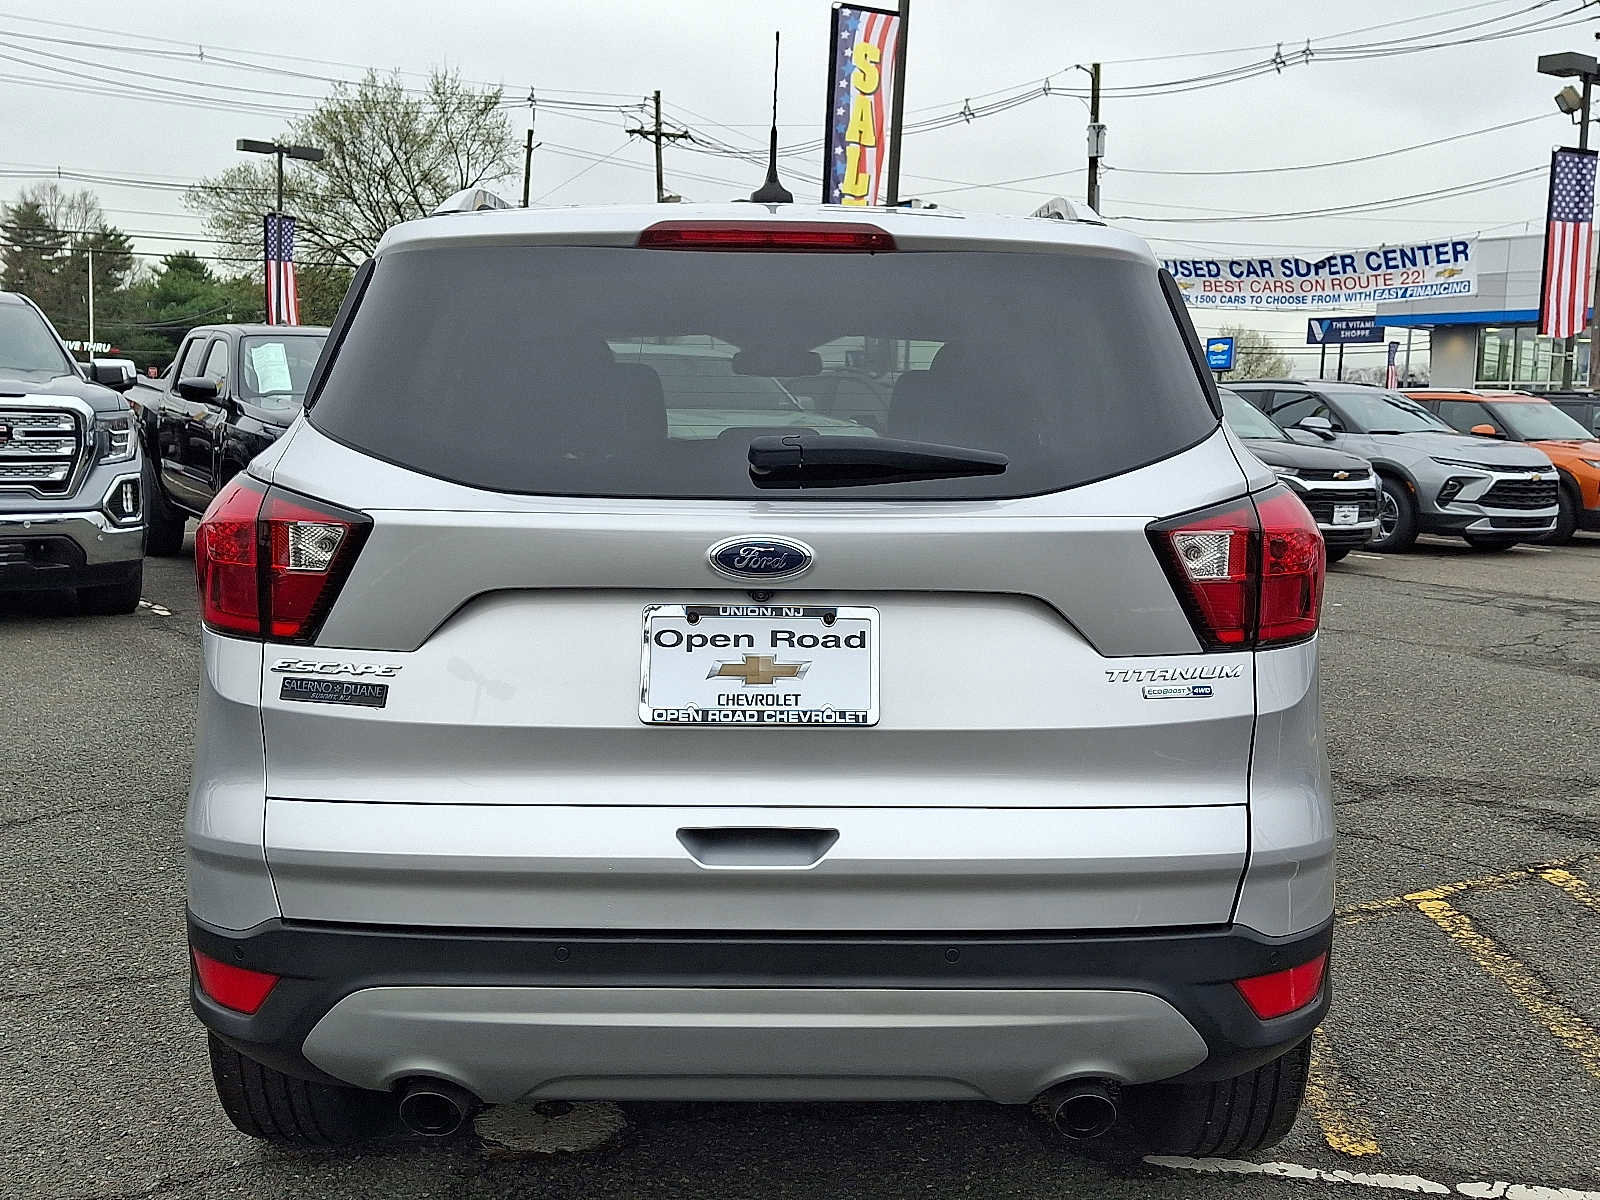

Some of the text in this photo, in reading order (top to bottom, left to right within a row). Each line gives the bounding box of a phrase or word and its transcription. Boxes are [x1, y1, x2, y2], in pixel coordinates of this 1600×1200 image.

[1163, 241, 1469, 278] USED CAR SUPER CENTER
[1203, 270, 1425, 293] BEST CARS ON ROUTE 22!
[1194, 295, 1217, 304] 1500
[1220, 295, 1246, 304] CARS
[1250, 295, 1263, 304] TO
[1265, 295, 1308, 305] CHOOSE
[1311, 293, 1341, 304] FROM
[1344, 291, 1372, 302] WITH
[1374, 288, 1405, 300] EASY
[1406, 282, 1469, 297] FINANCING
[1332, 320, 1377, 329] THE VITAMI
[734, 546, 788, 569] Ford
[782, 605, 805, 617] NJ
[654, 629, 866, 652] Open Road
[270, 658, 403, 677] ESCAPE
[1105, 664, 1245, 683] TITANIUM
[283, 680, 384, 697] SALERNO DUANE
[717, 693, 802, 707] CHEVROLET
[653, 709, 866, 723] OPEN ROAD CHEVROLET
